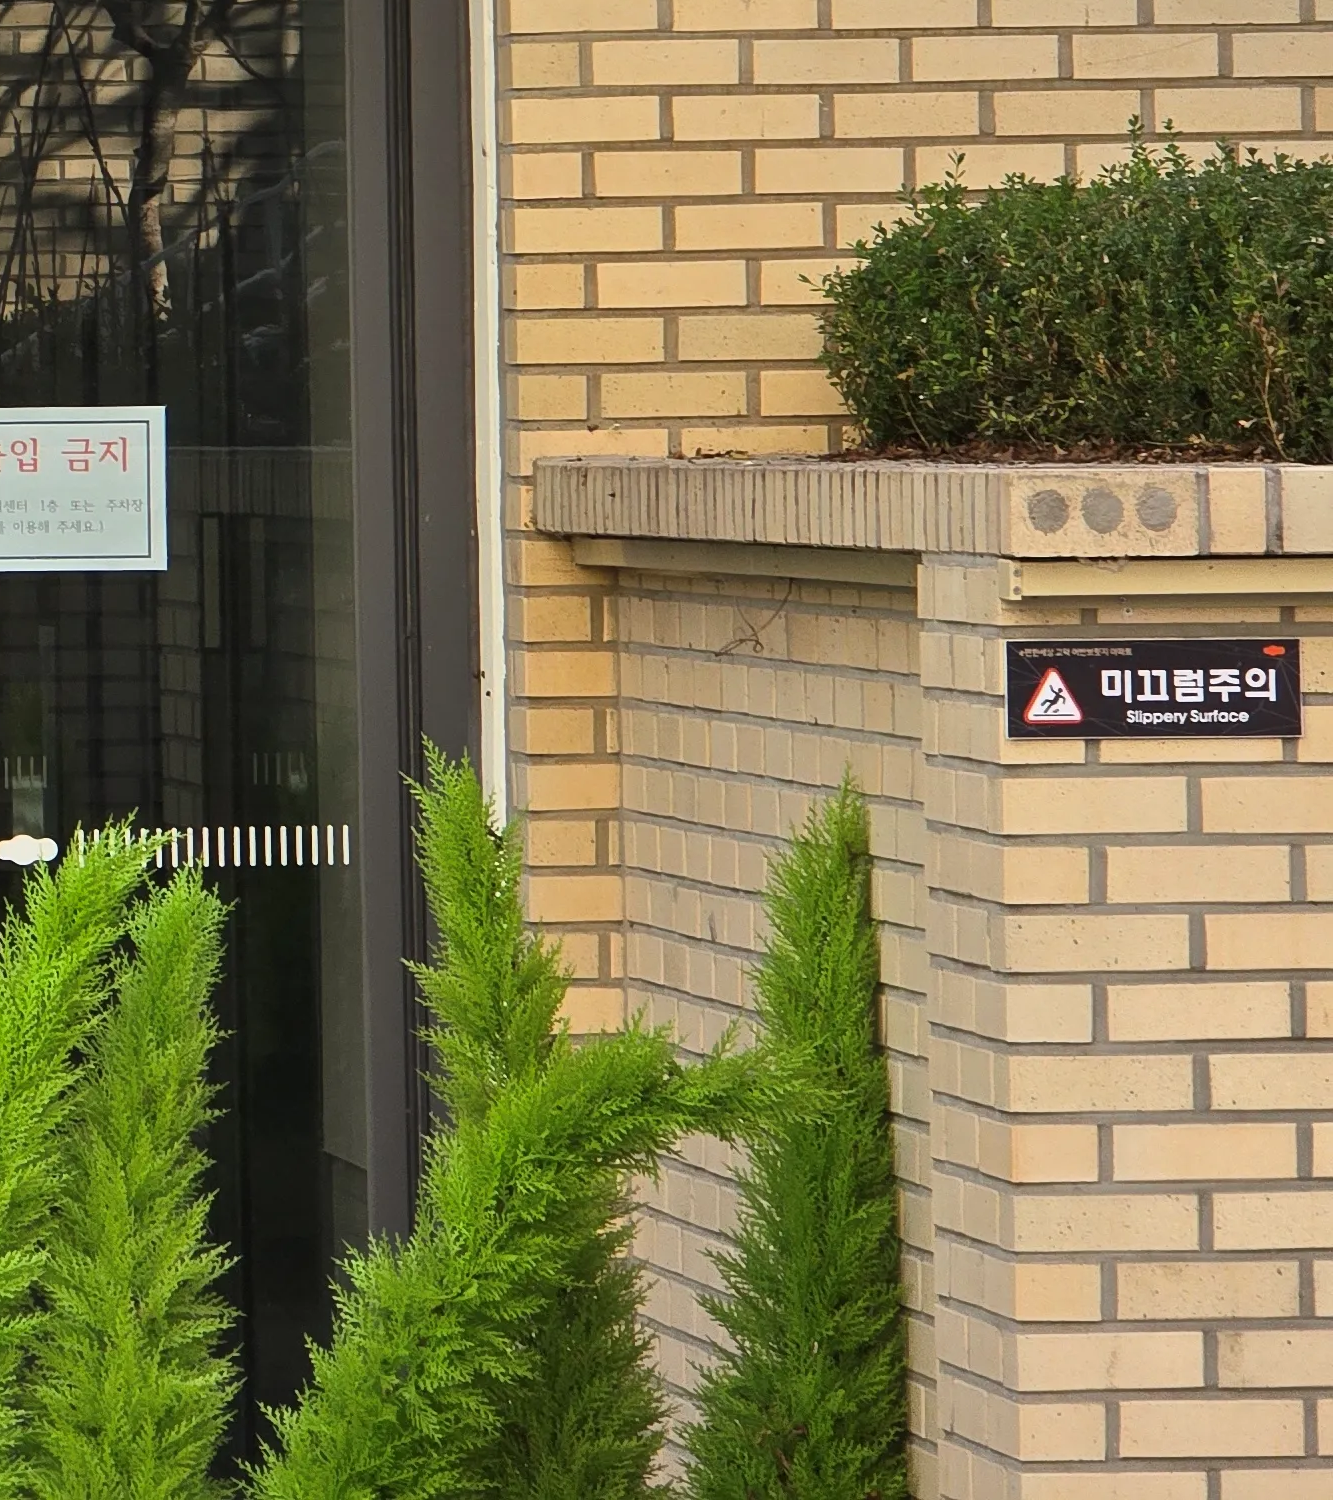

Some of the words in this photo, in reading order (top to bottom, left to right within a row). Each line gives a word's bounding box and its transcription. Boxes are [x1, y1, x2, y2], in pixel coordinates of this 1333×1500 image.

[61, 436, 129, 473] 금지
[70, 499, 95, 513] 또는
[106, 499, 144, 513] 주차장
[13, 519, 50, 534] 이용해
[1100, 667, 1277, 704] 미끄럼주의
[1125, 709, 1189, 725] Slippery
[1189, 709, 1250, 723] Surface
